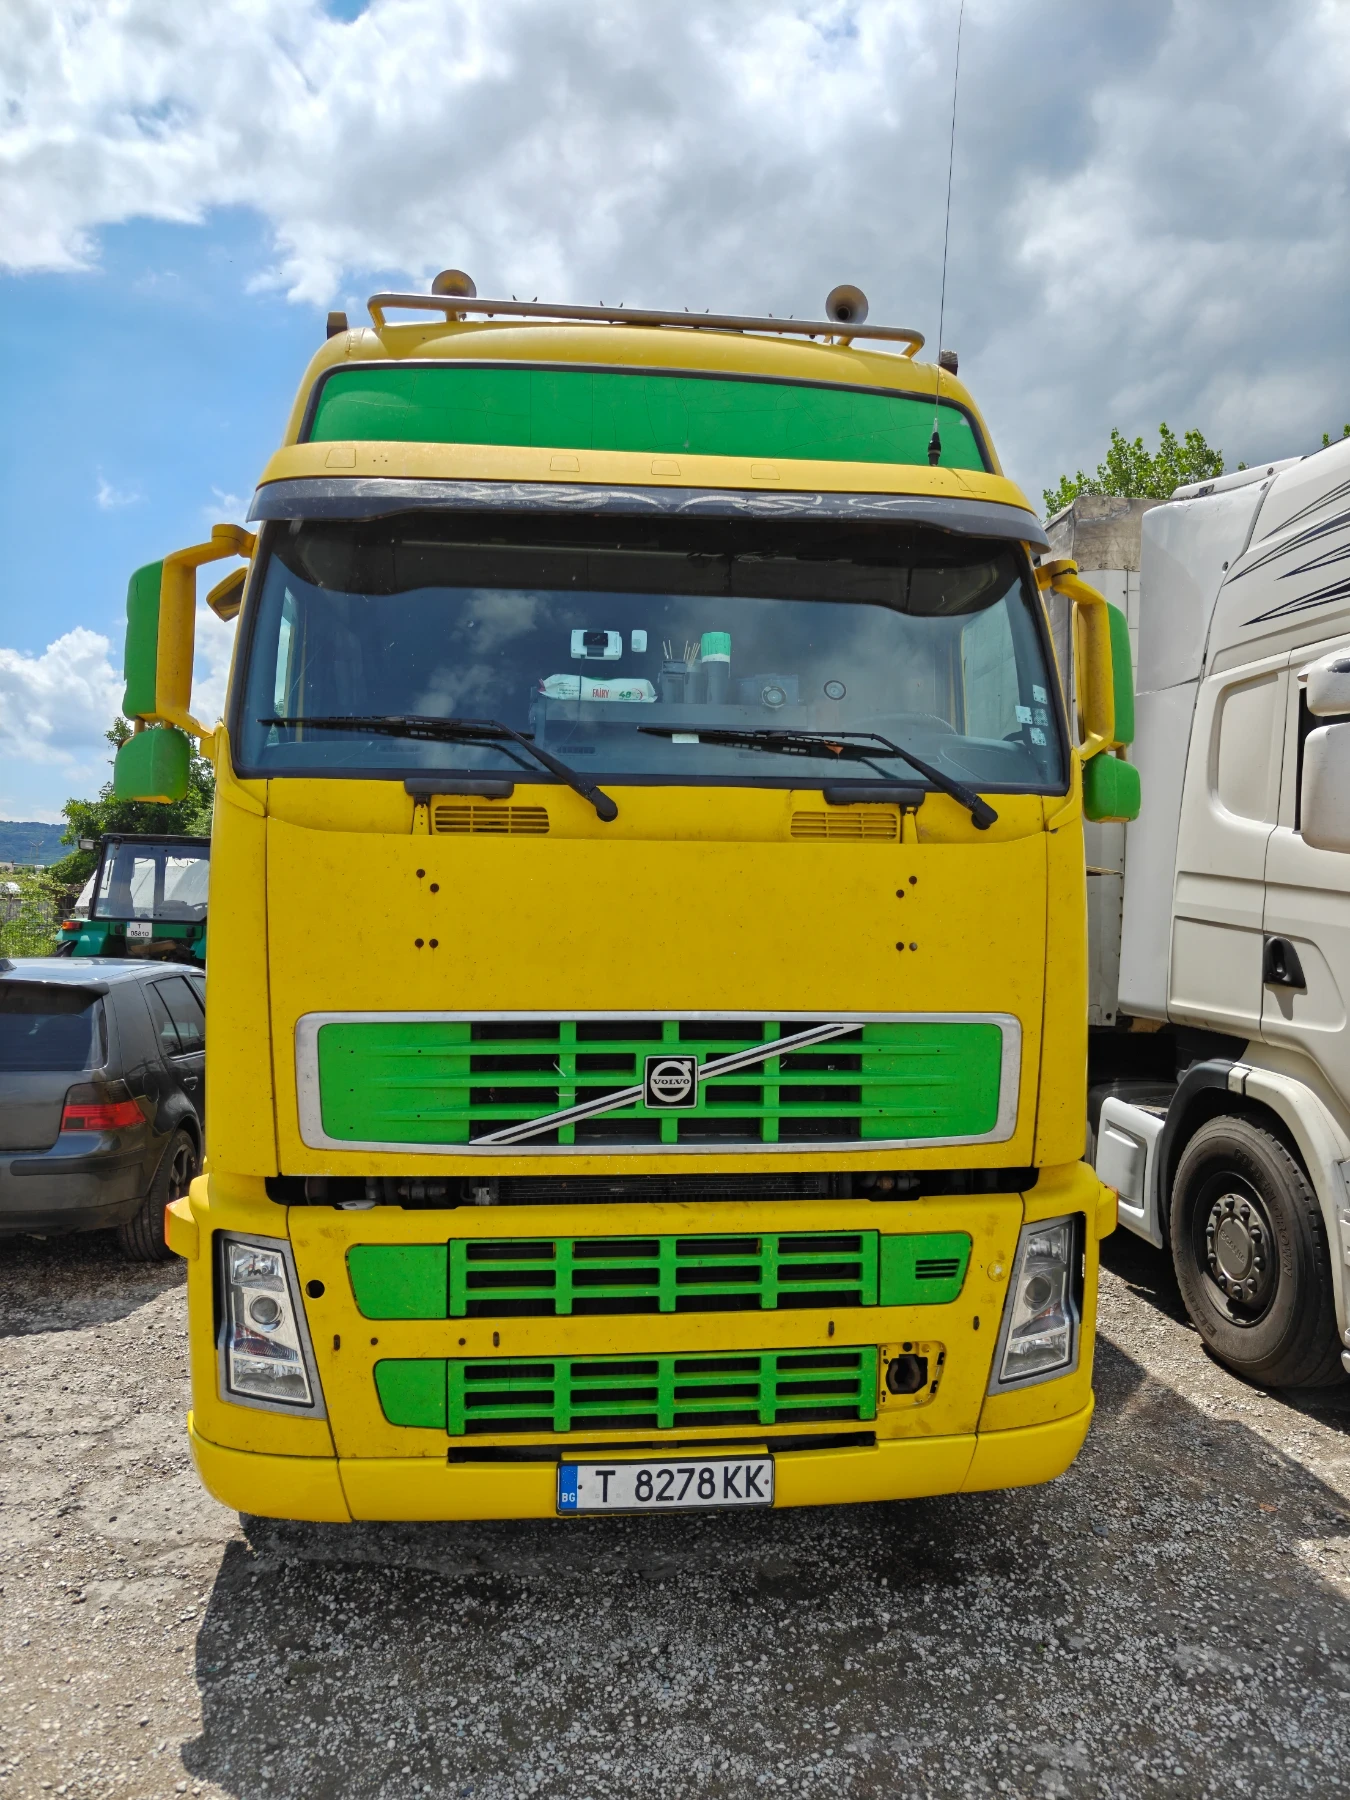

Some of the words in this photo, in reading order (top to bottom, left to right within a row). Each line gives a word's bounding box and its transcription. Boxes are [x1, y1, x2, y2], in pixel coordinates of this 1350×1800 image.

[592, 688, 609, 698] FAIRY
[595, 1470, 616, 1502] T
[561, 1493, 576, 1502] BG
